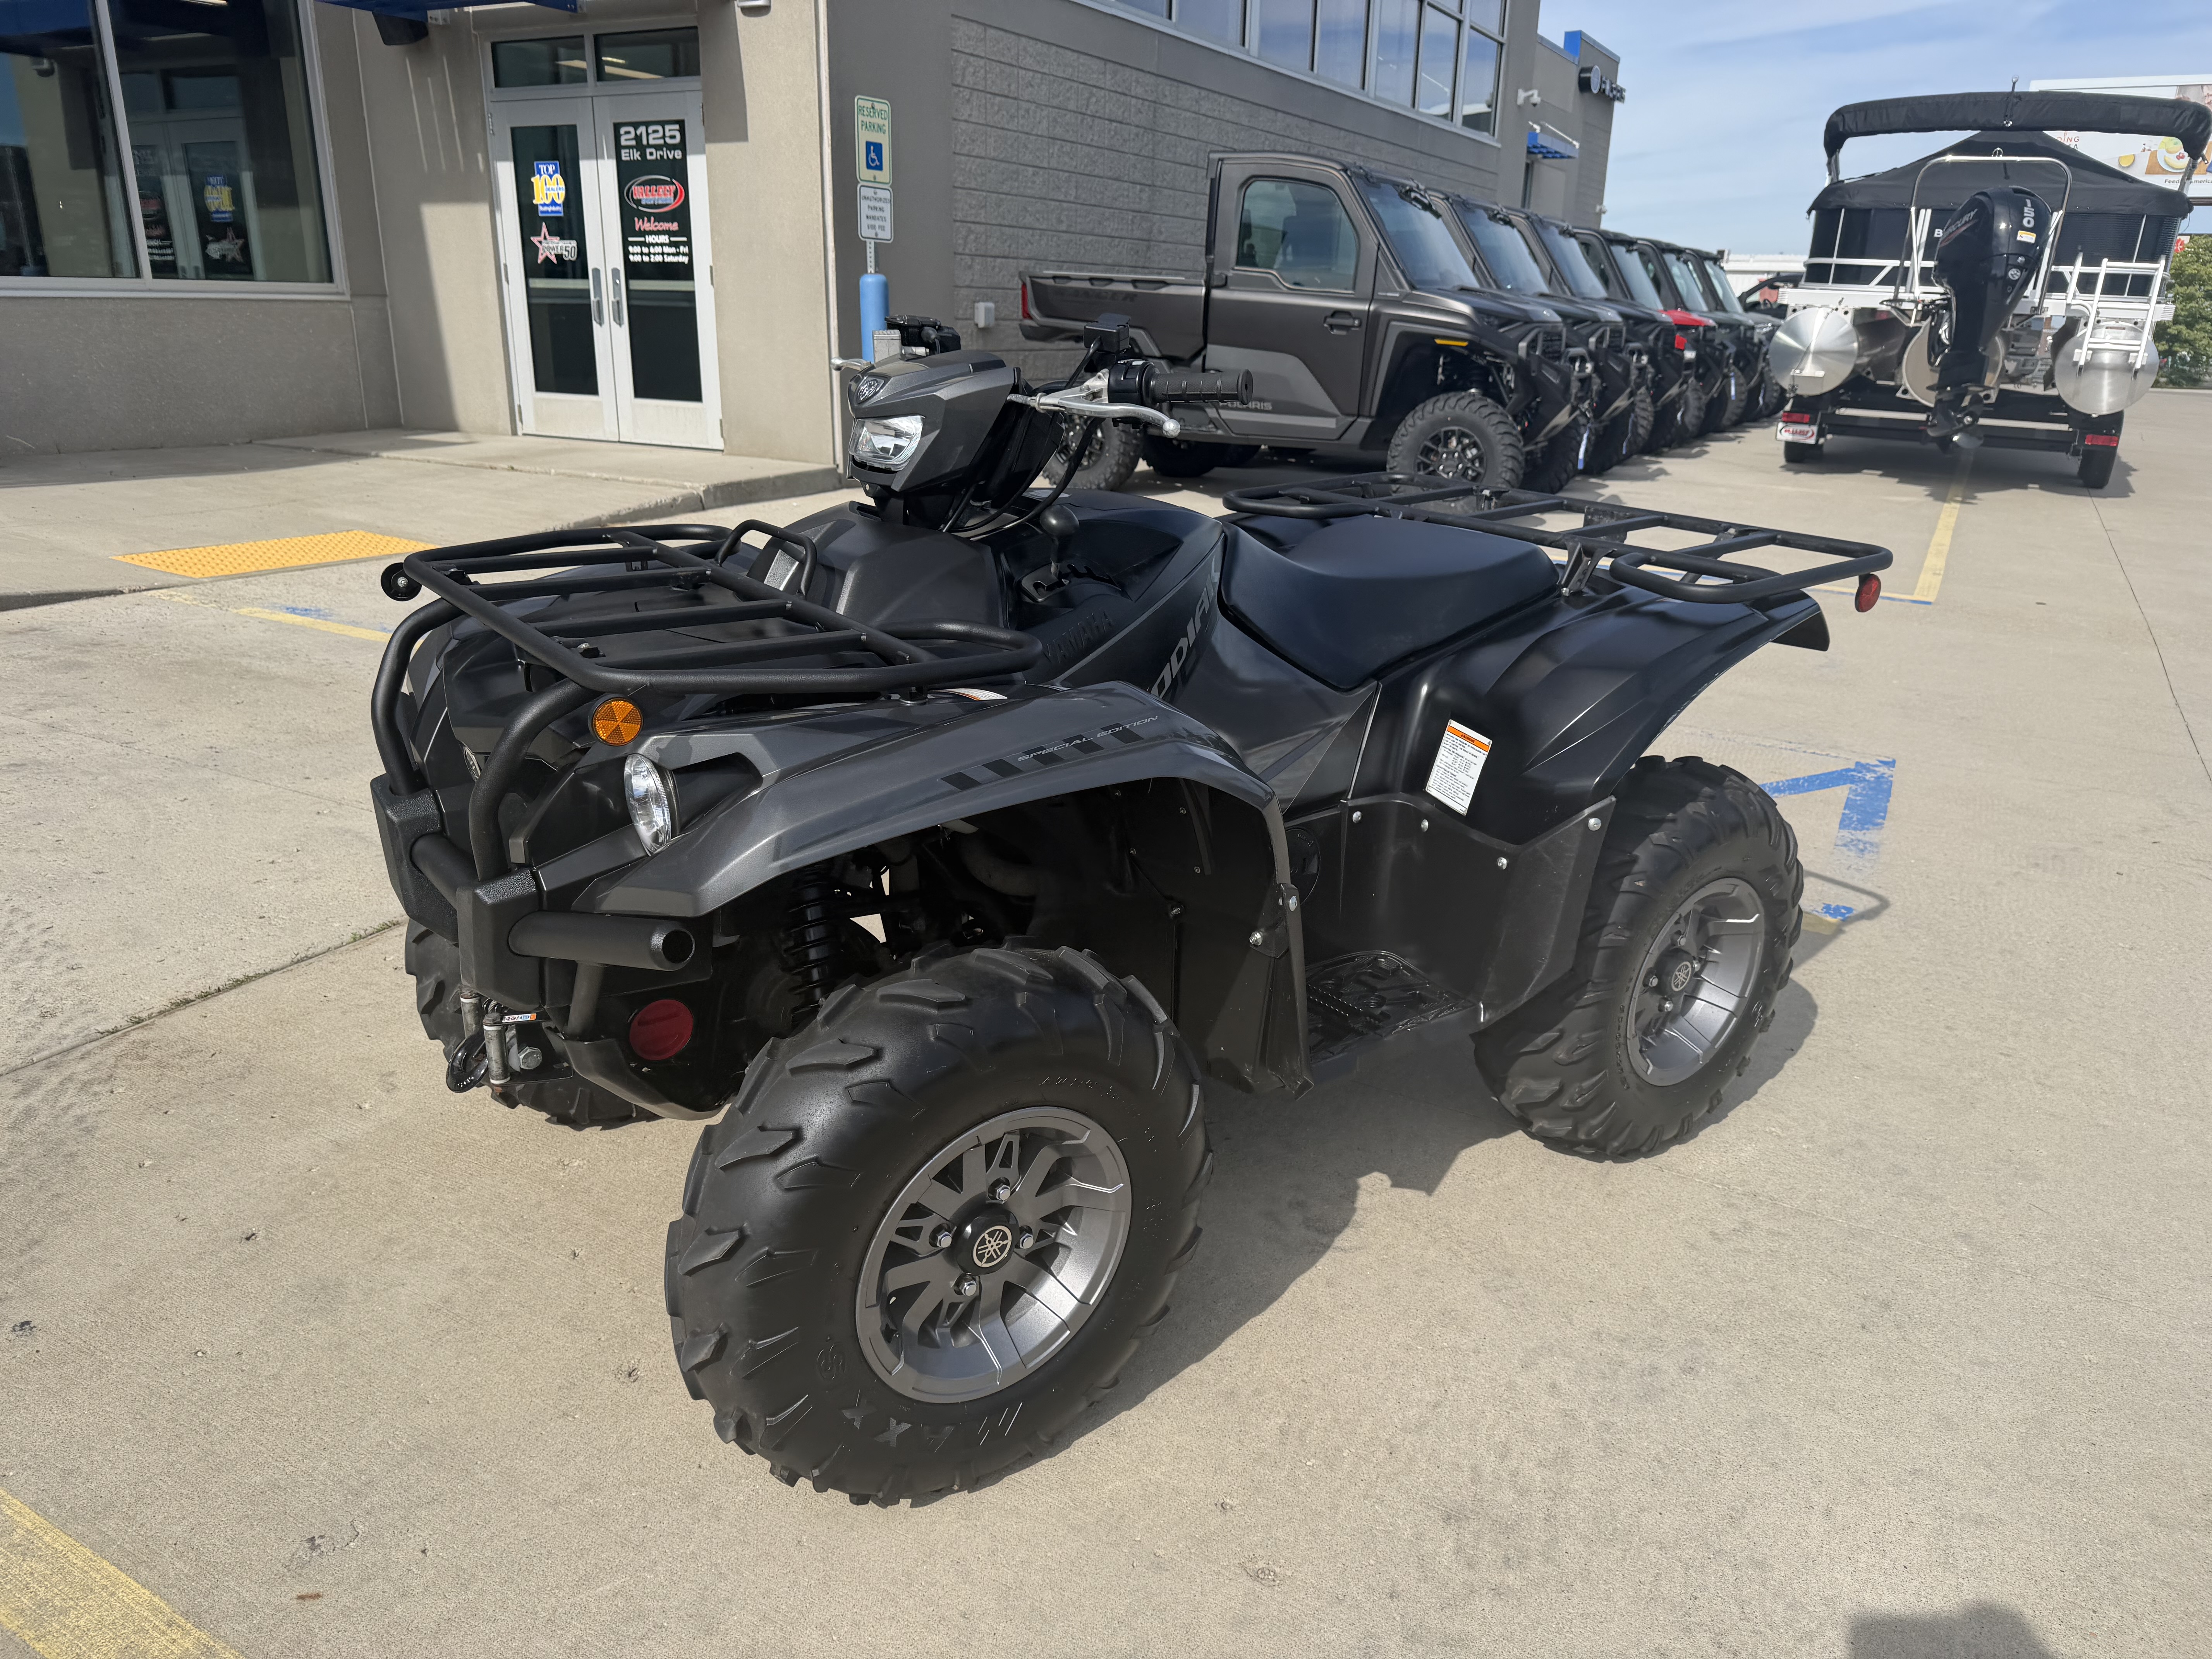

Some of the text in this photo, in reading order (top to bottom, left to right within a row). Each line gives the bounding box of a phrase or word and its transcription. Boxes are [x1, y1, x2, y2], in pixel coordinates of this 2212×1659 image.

[859, 105, 888, 120] RESERVED
[861, 120, 886, 134] PARKING
[620, 124, 681, 146] 2125
[621, 147, 682, 161] Elk Drive
[539, 164, 555, 174] TOP
[531, 174, 565, 204] 100
[2023, 199, 2035, 228] 150
[634, 216, 679, 231] Welcome
[646, 234, 669, 244] HOURS
[564, 245, 575, 258] 50
[663, 245, 676, 254] Mon
[680, 245, 689, 254] Fri
[663, 254, 689, 264] Saturday
[1017, 716, 1158, 762] SPECIAL EDITION
